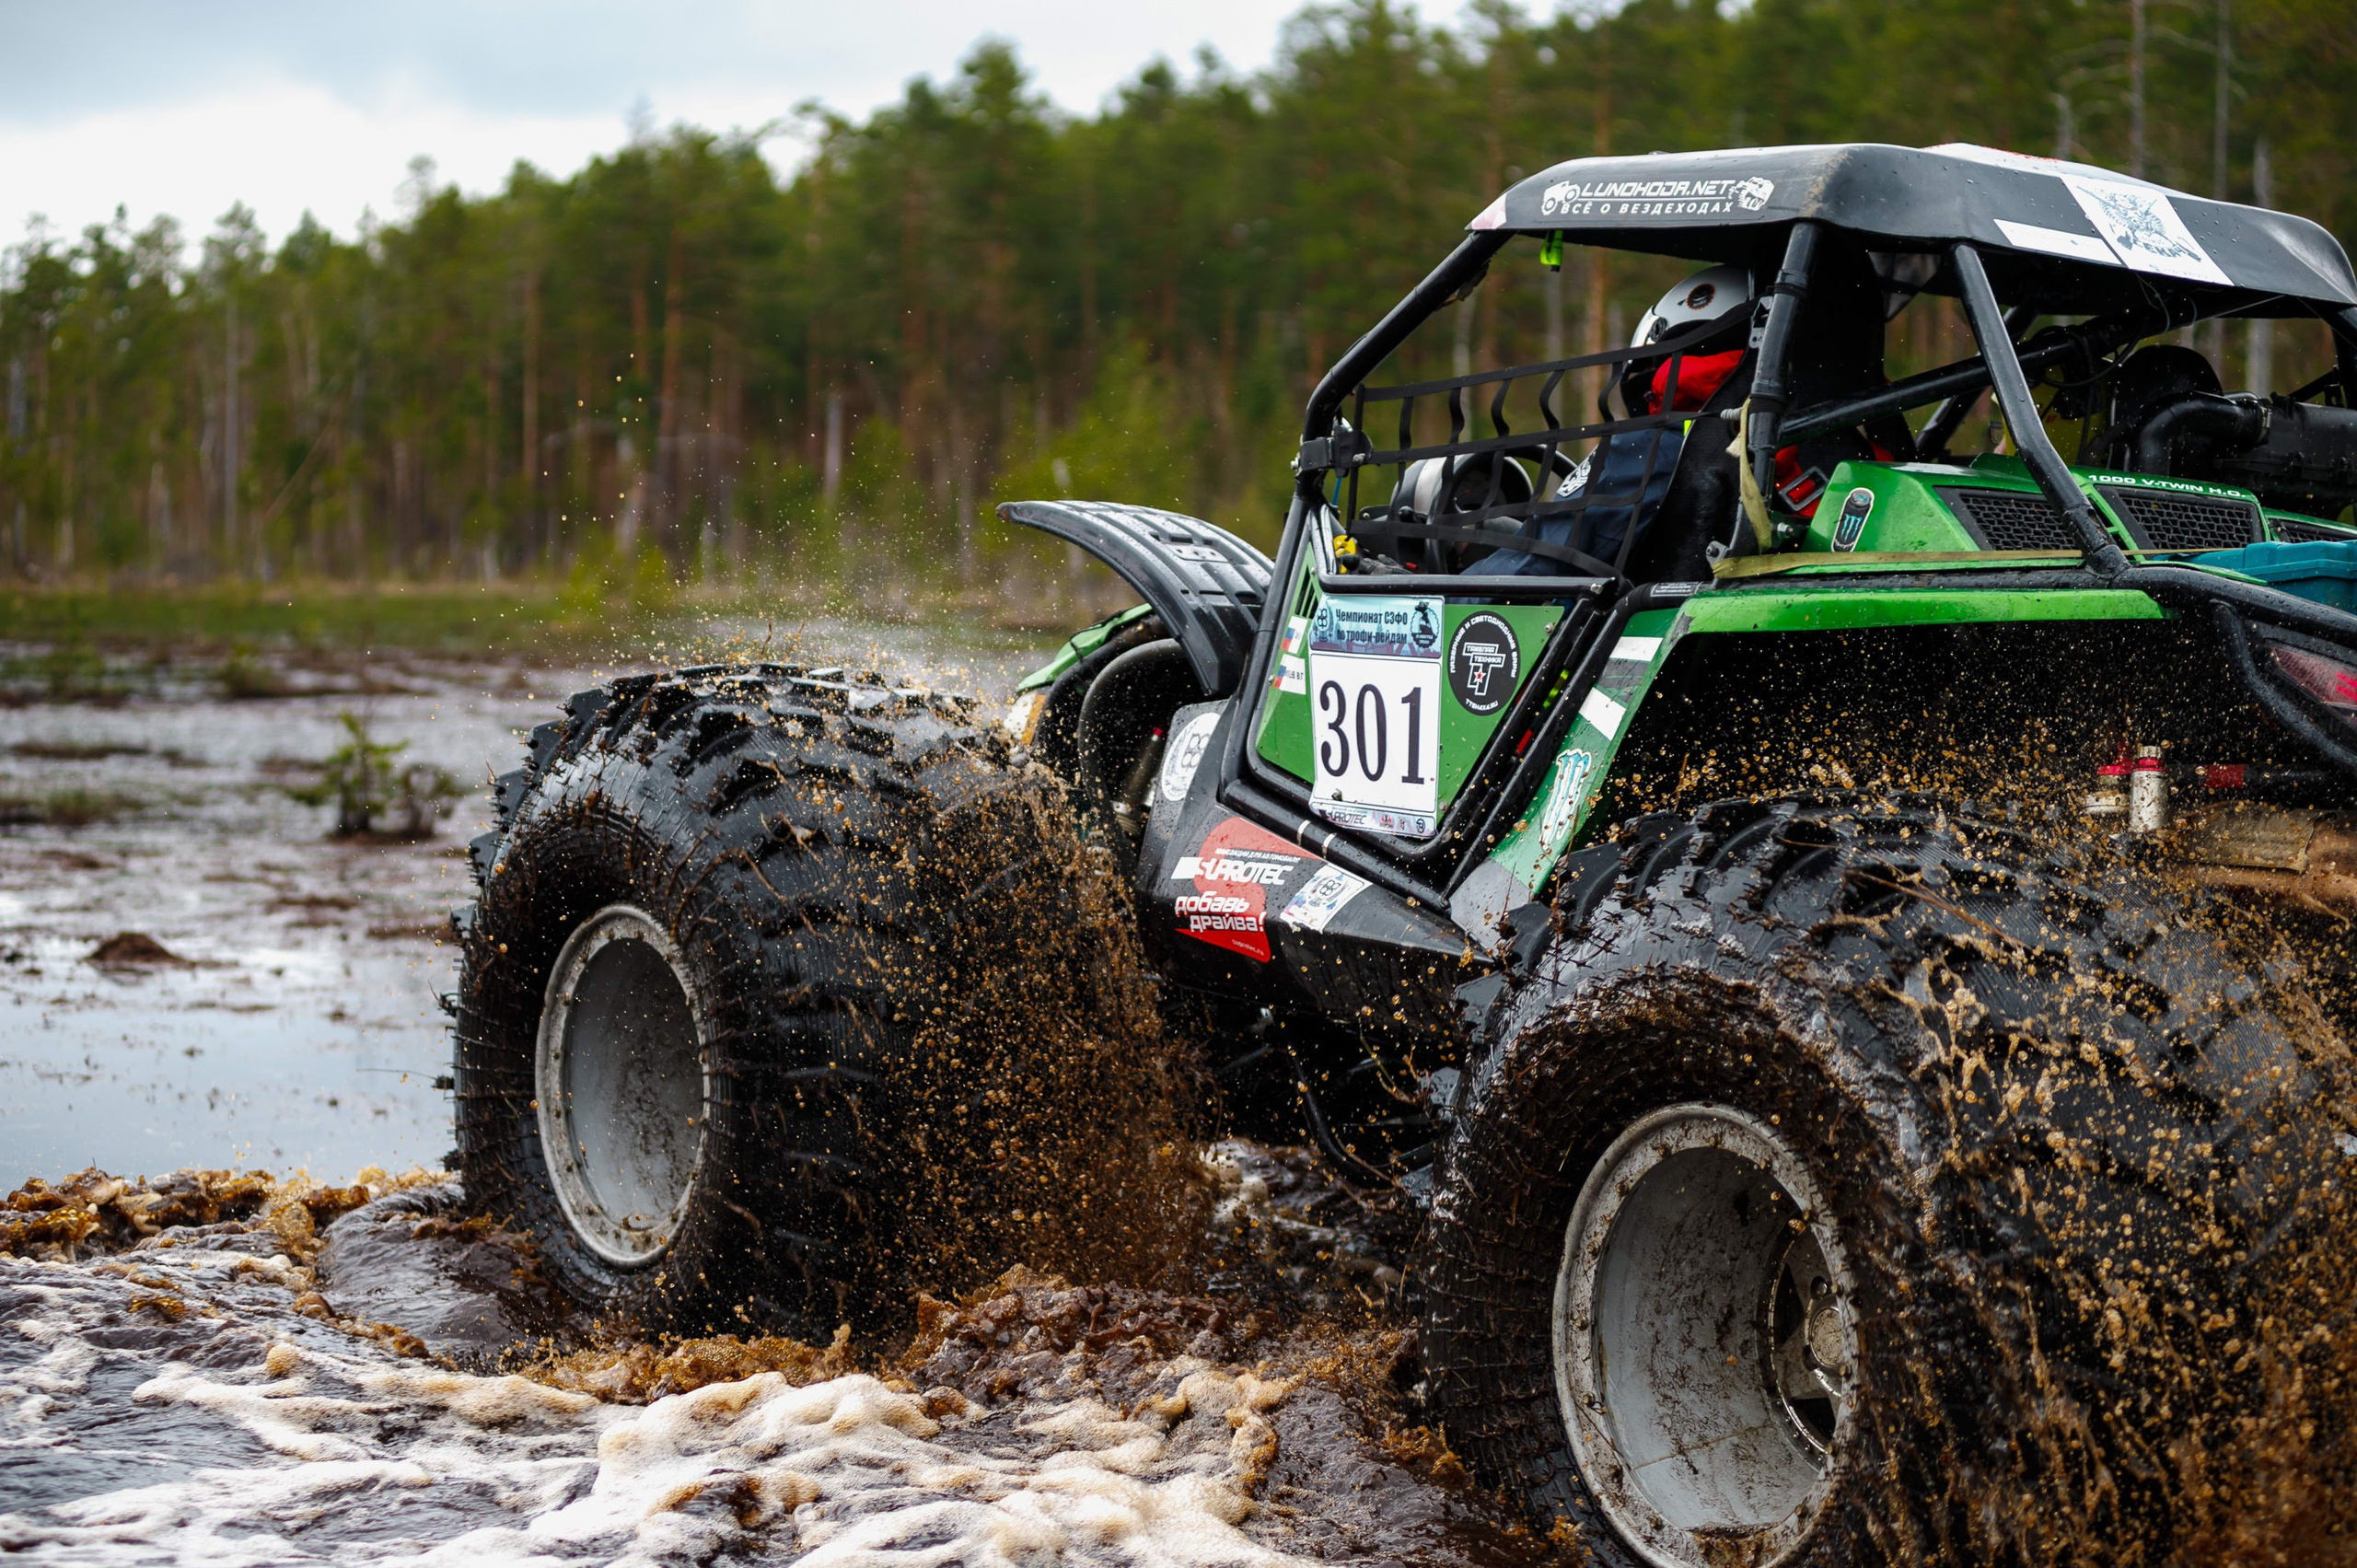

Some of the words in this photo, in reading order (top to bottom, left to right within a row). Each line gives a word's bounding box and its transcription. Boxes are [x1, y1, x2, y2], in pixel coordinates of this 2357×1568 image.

[1580, 180, 1736, 198] LUNOHODA.NET
[1560, 200, 1592, 215] ВСЁ
[1600, 202, 1610, 215] О
[1619, 201, 1734, 215] ВЕЗДЕХОДАХ
[2088, 474, 2136, 484] 1000
[2141, 478, 2204, 493] V-TWIN
[2208, 486, 2247, 498] H.O.
[1335, 608, 1383, 625] Чемпионат
[1346, 630, 1408, 645] трофи-рейдам
[1473, 655, 1502, 664] ТЕХНИКА
[1318, 680, 1425, 785] 301
[1184, 857, 1294, 886] SUPROTEC
[1175, 890, 1250, 918] добавь
[1190, 911, 1268, 934] драйва!
